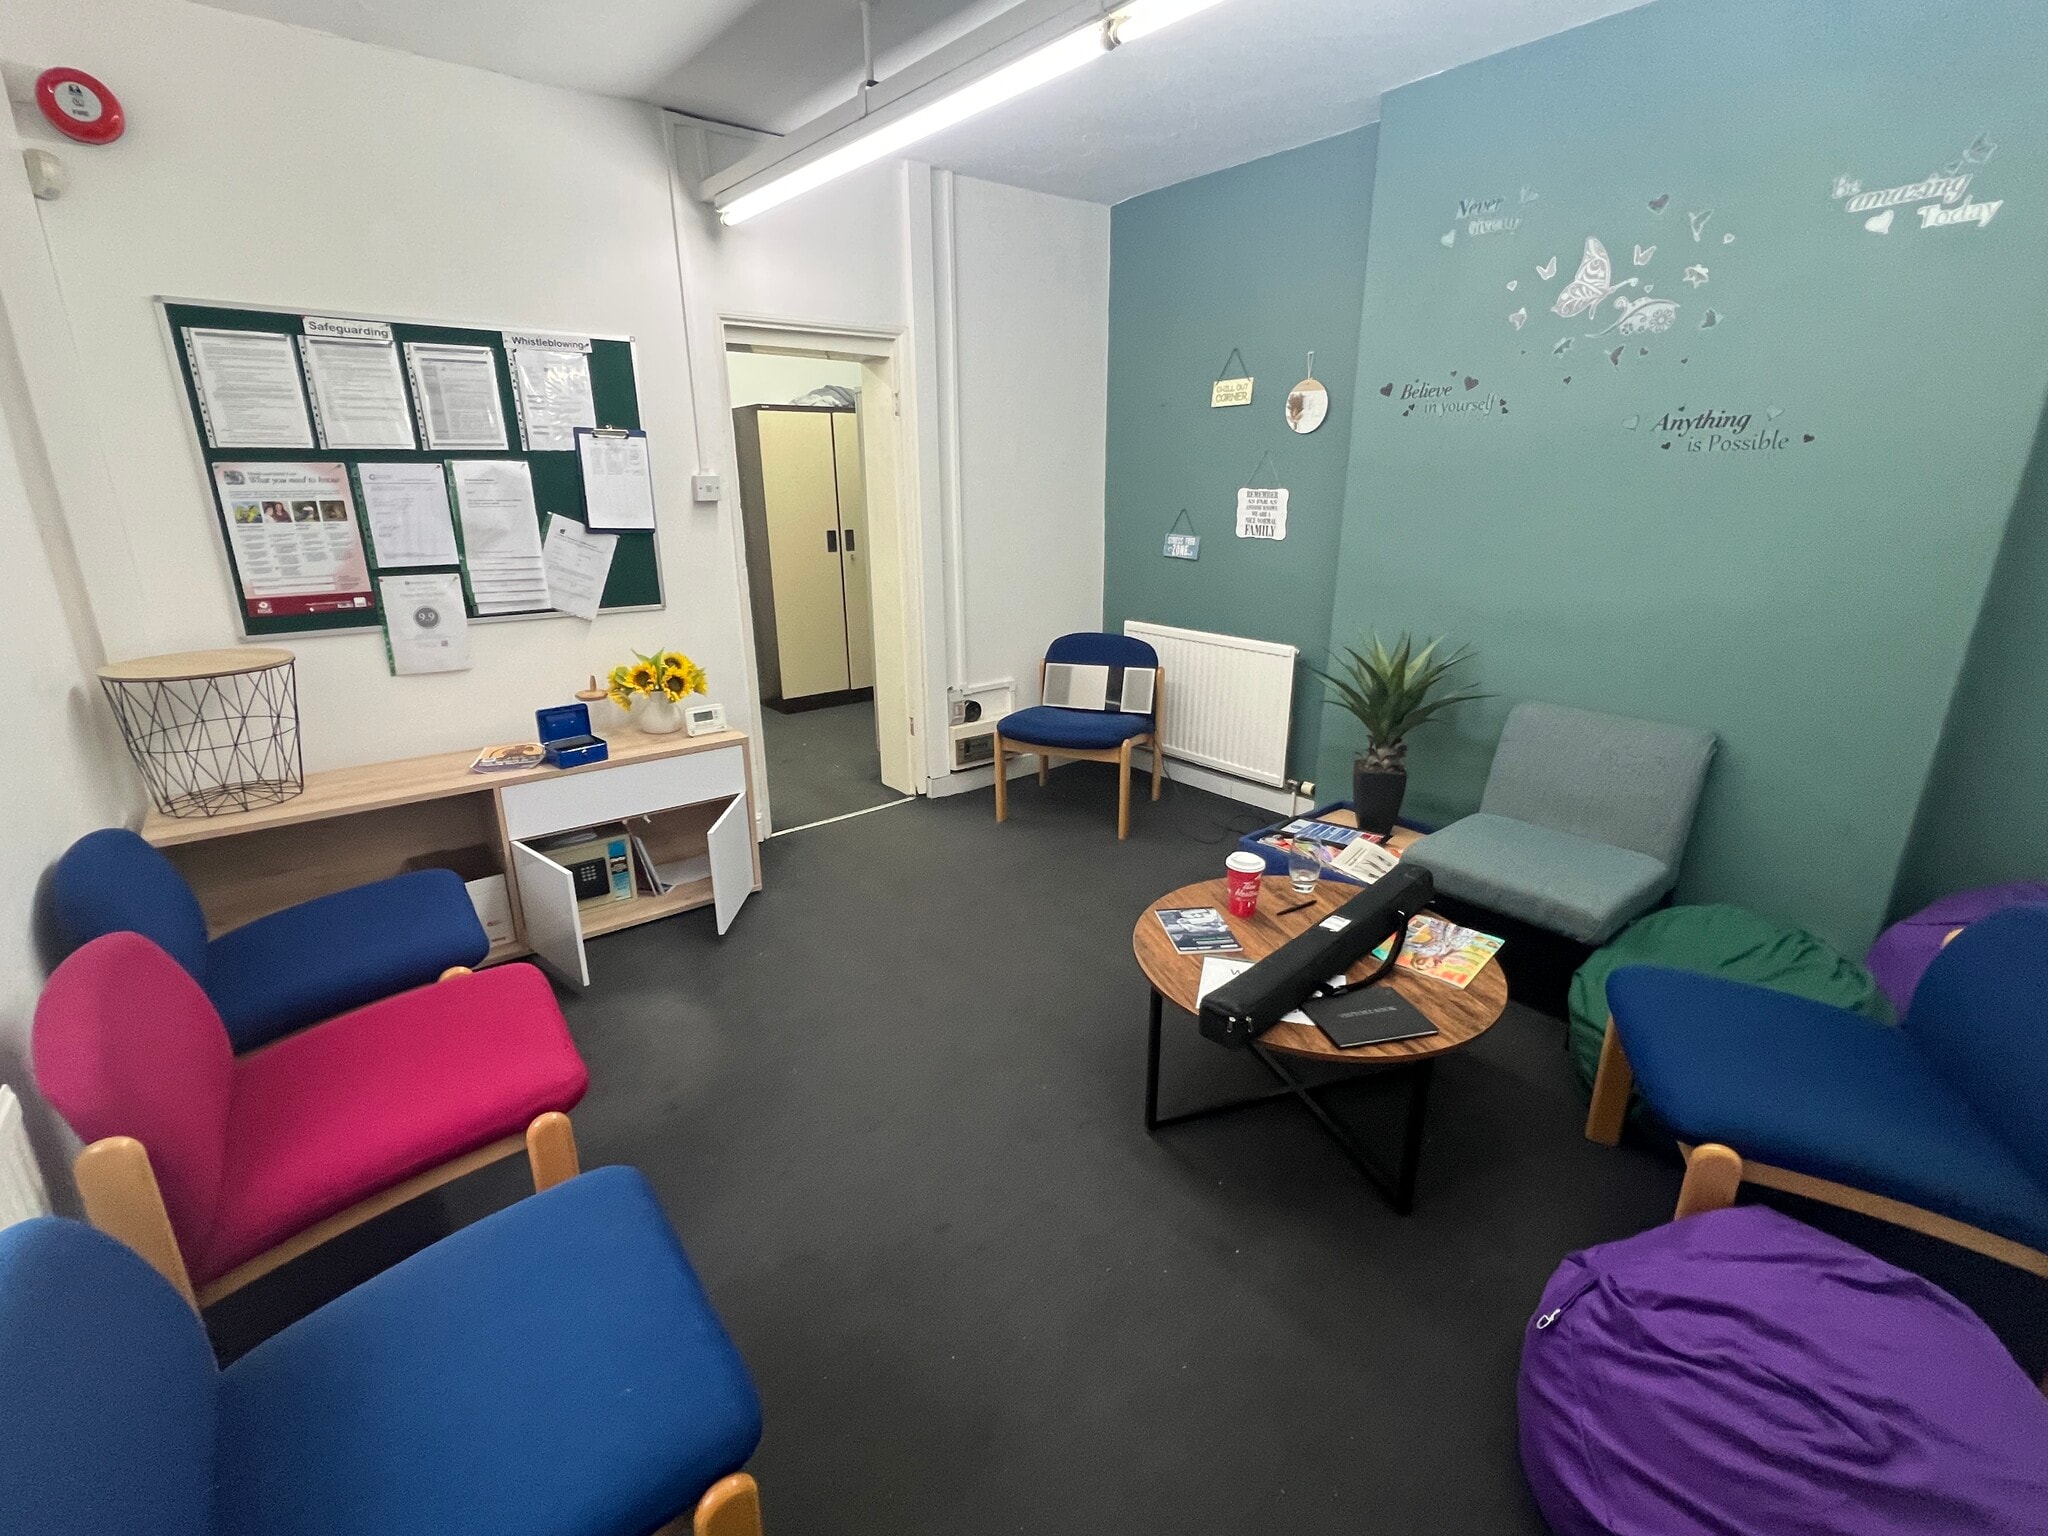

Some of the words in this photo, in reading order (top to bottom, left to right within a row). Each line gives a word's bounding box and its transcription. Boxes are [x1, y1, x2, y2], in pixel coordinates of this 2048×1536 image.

[1455, 198, 1505, 220] Never
[1917, 194, 2004, 228] Today
[308, 321, 389, 338] Safeguarding
[511, 336, 584, 350] Whistleblowing
[1216, 385, 1235, 393] CHILL
[1236, 383, 1249, 391] OUT
[1216, 392, 1247, 402] CORNER
[1400, 382, 1453, 400] Believe
[1424, 400, 1437, 413] in
[1439, 393, 1498, 417] yourself
[1651, 409, 1752, 437] Anything
[1687, 436, 1702, 452] is
[1709, 429, 1789, 452] Possible
[1244, 524, 1276, 537] FAMILY
